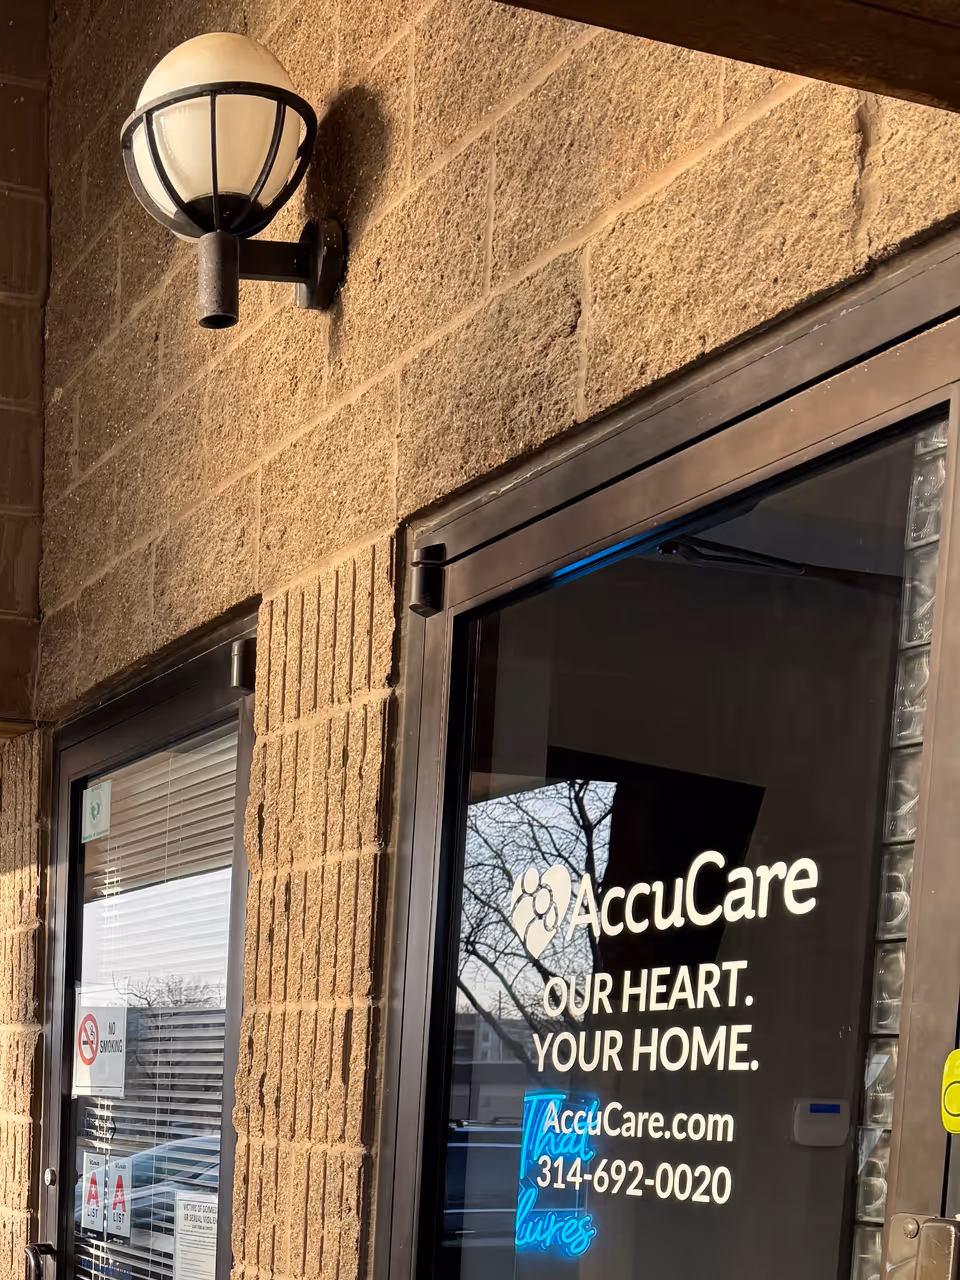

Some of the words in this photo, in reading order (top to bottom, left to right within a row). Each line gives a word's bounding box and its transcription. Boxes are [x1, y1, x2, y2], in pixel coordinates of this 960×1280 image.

[566, 850, 819, 942] AccuCare
[543, 972, 613, 1017] OUR
[622, 960, 754, 1014] HEART.
[99, 1039, 123, 1054] SMOKING
[107, 1022, 116, 1036] NO
[533, 1029, 623, 1072] YOUR
[632, 1025, 760, 1072] HOME.
[543, 1102, 735, 1142] AccuCare.com
[537, 1155, 732, 1204] 314-692-0020
[86, 1207, 99, 1219] LIST
[112, 1212, 125, 1224] LIST
